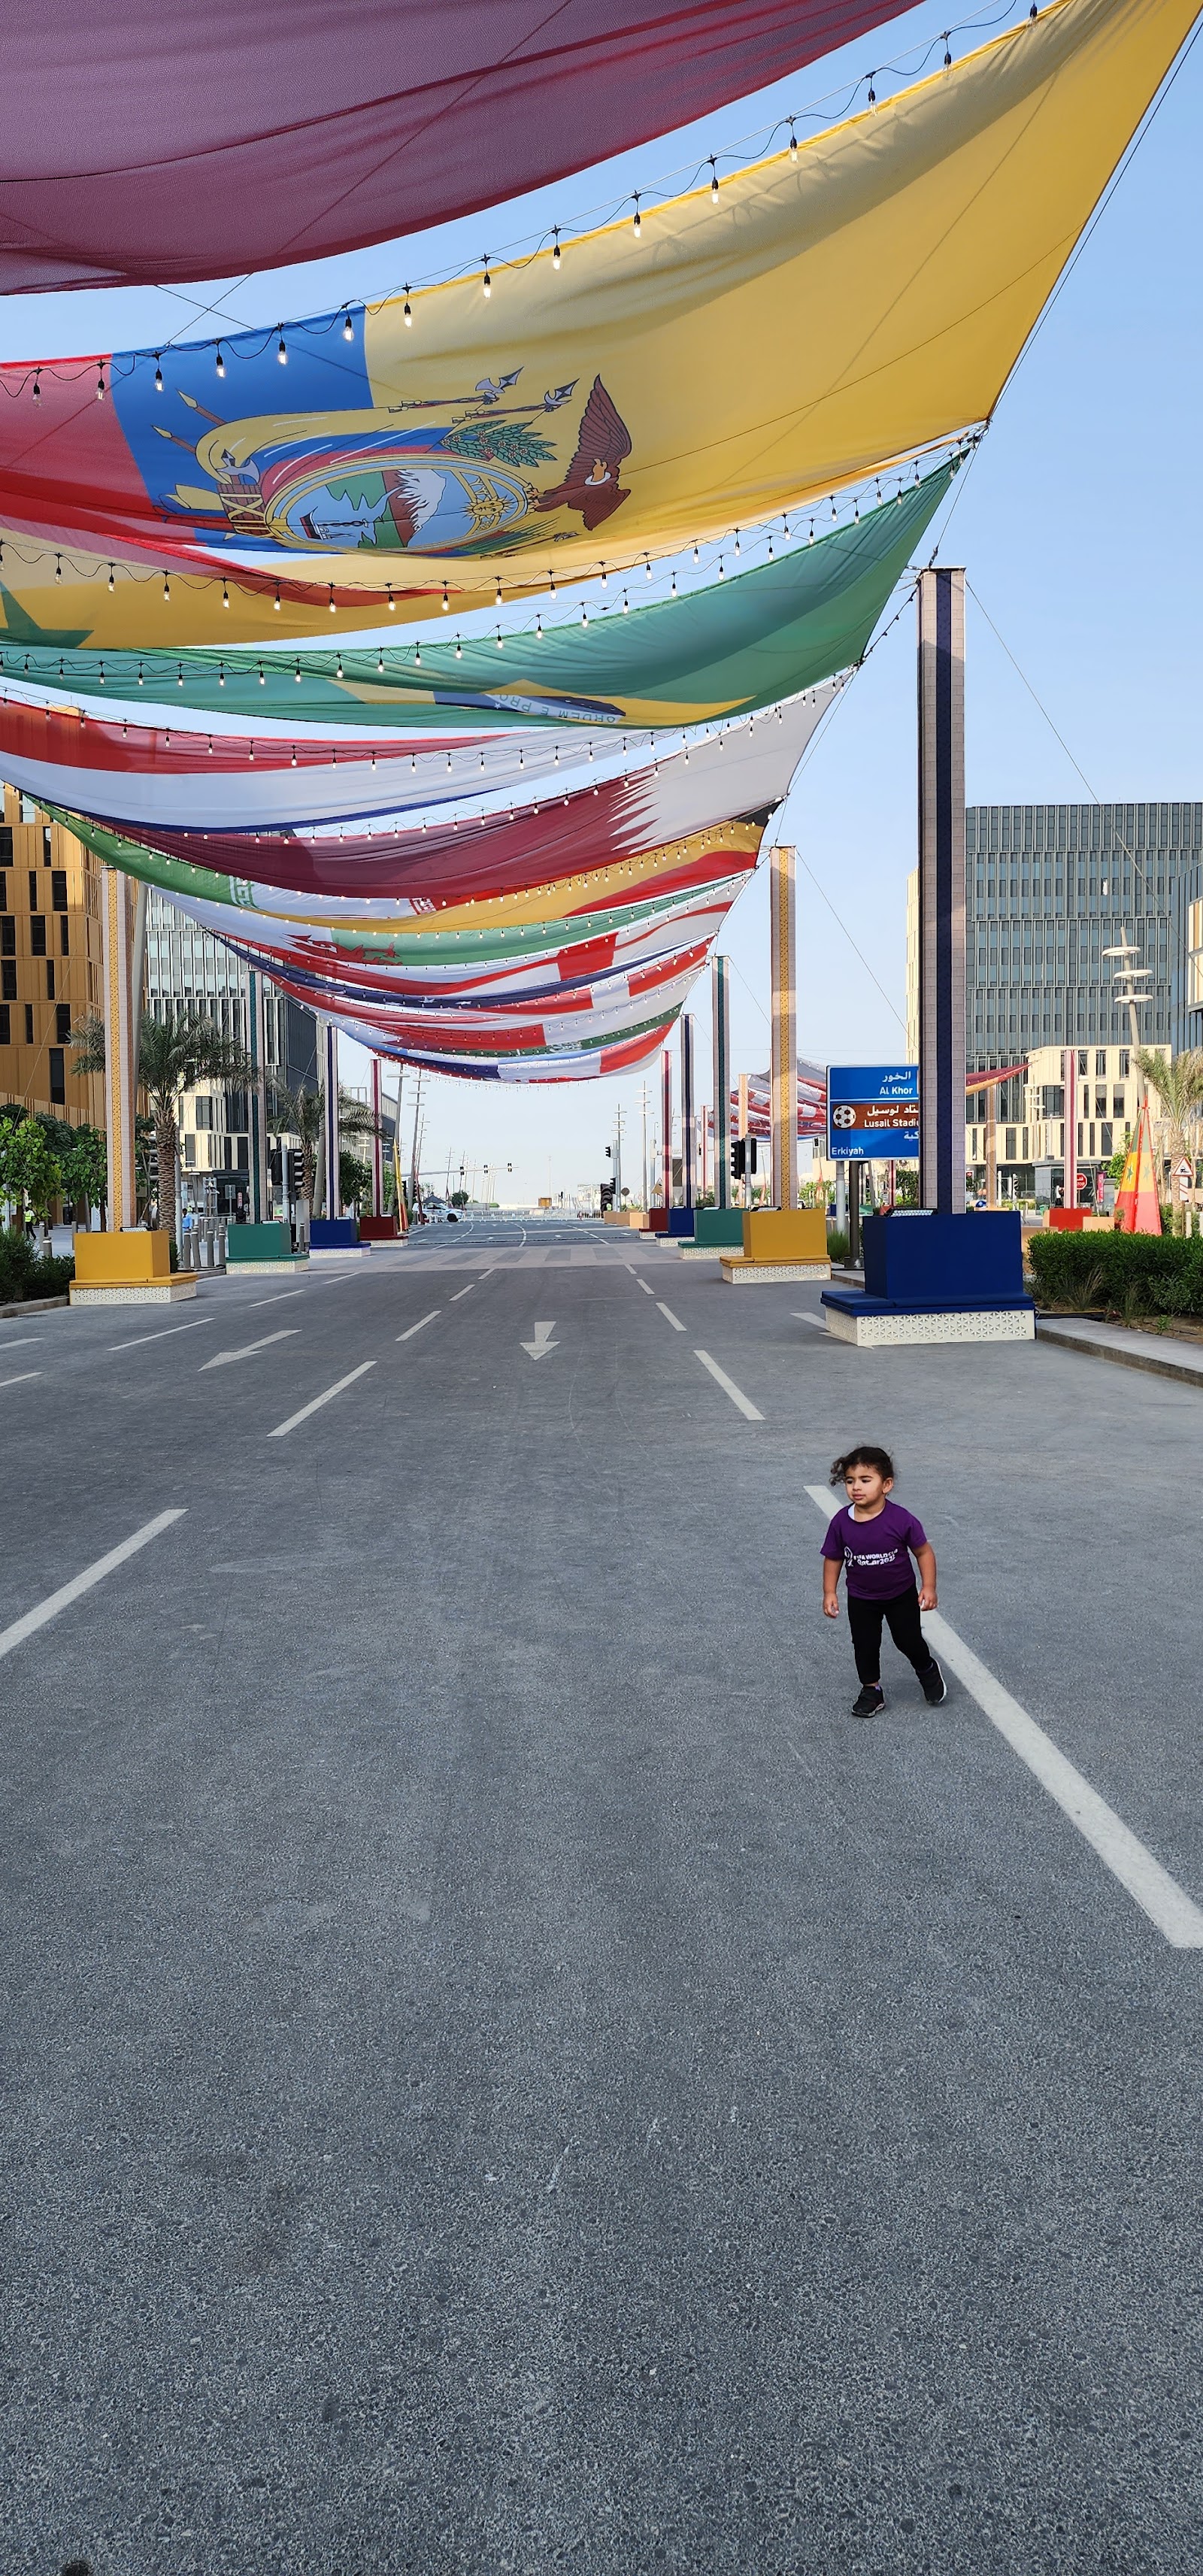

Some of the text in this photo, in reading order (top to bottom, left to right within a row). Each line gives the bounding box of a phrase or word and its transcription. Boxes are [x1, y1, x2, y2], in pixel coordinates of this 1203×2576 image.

[540, 706, 549, 715] E
[882, 1071, 911, 1083] الخور
[880, 1086, 913, 1095] Al Khor
[867, 1105, 899, 1117] لوسيل
[864, 1119, 890, 1128] Lusail
[832, 1147, 864, 1156] Erkiyah
